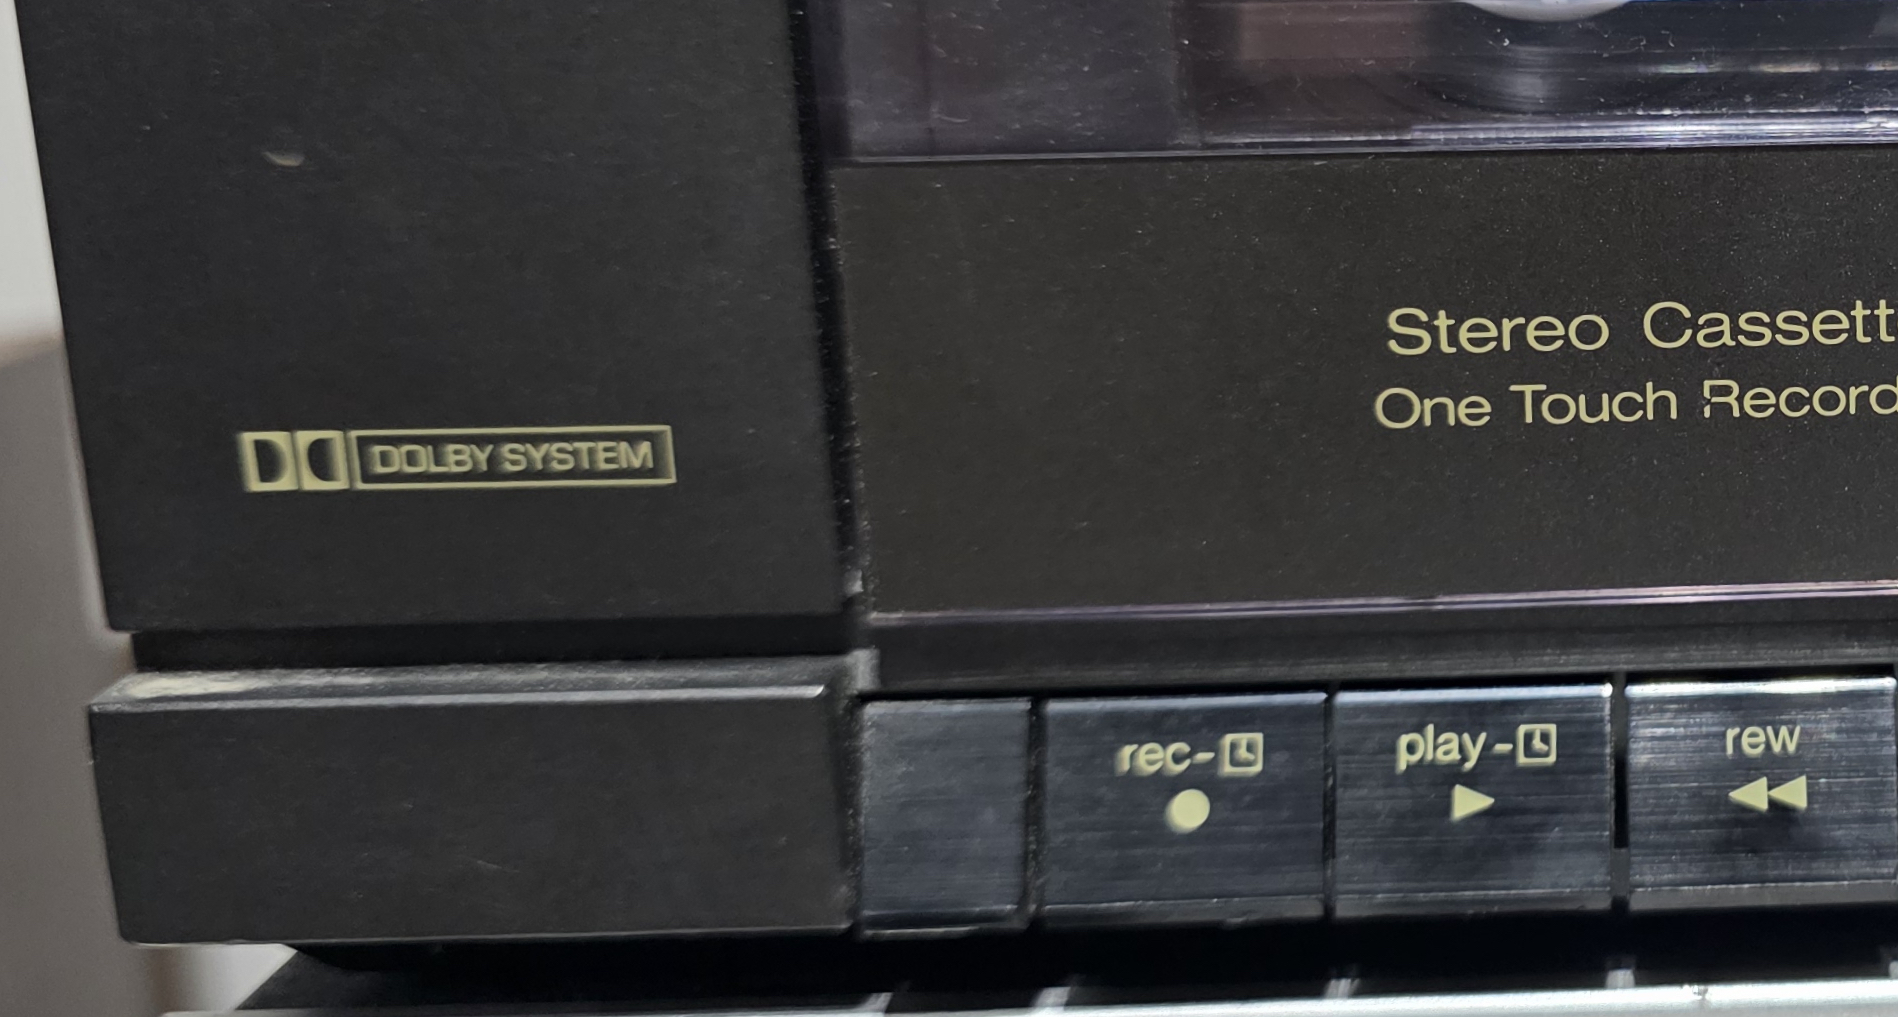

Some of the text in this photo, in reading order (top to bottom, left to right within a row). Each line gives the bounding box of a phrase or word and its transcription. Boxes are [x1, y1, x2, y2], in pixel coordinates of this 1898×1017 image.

[1387, 307, 1610, 356] Stereo
[1374, 387, 1492, 429] One
[1508, 381, 1678, 425] Touch
[369, 440, 654, 474] DOLBY SYSTEM
[1725, 724, 1802, 756] rew
